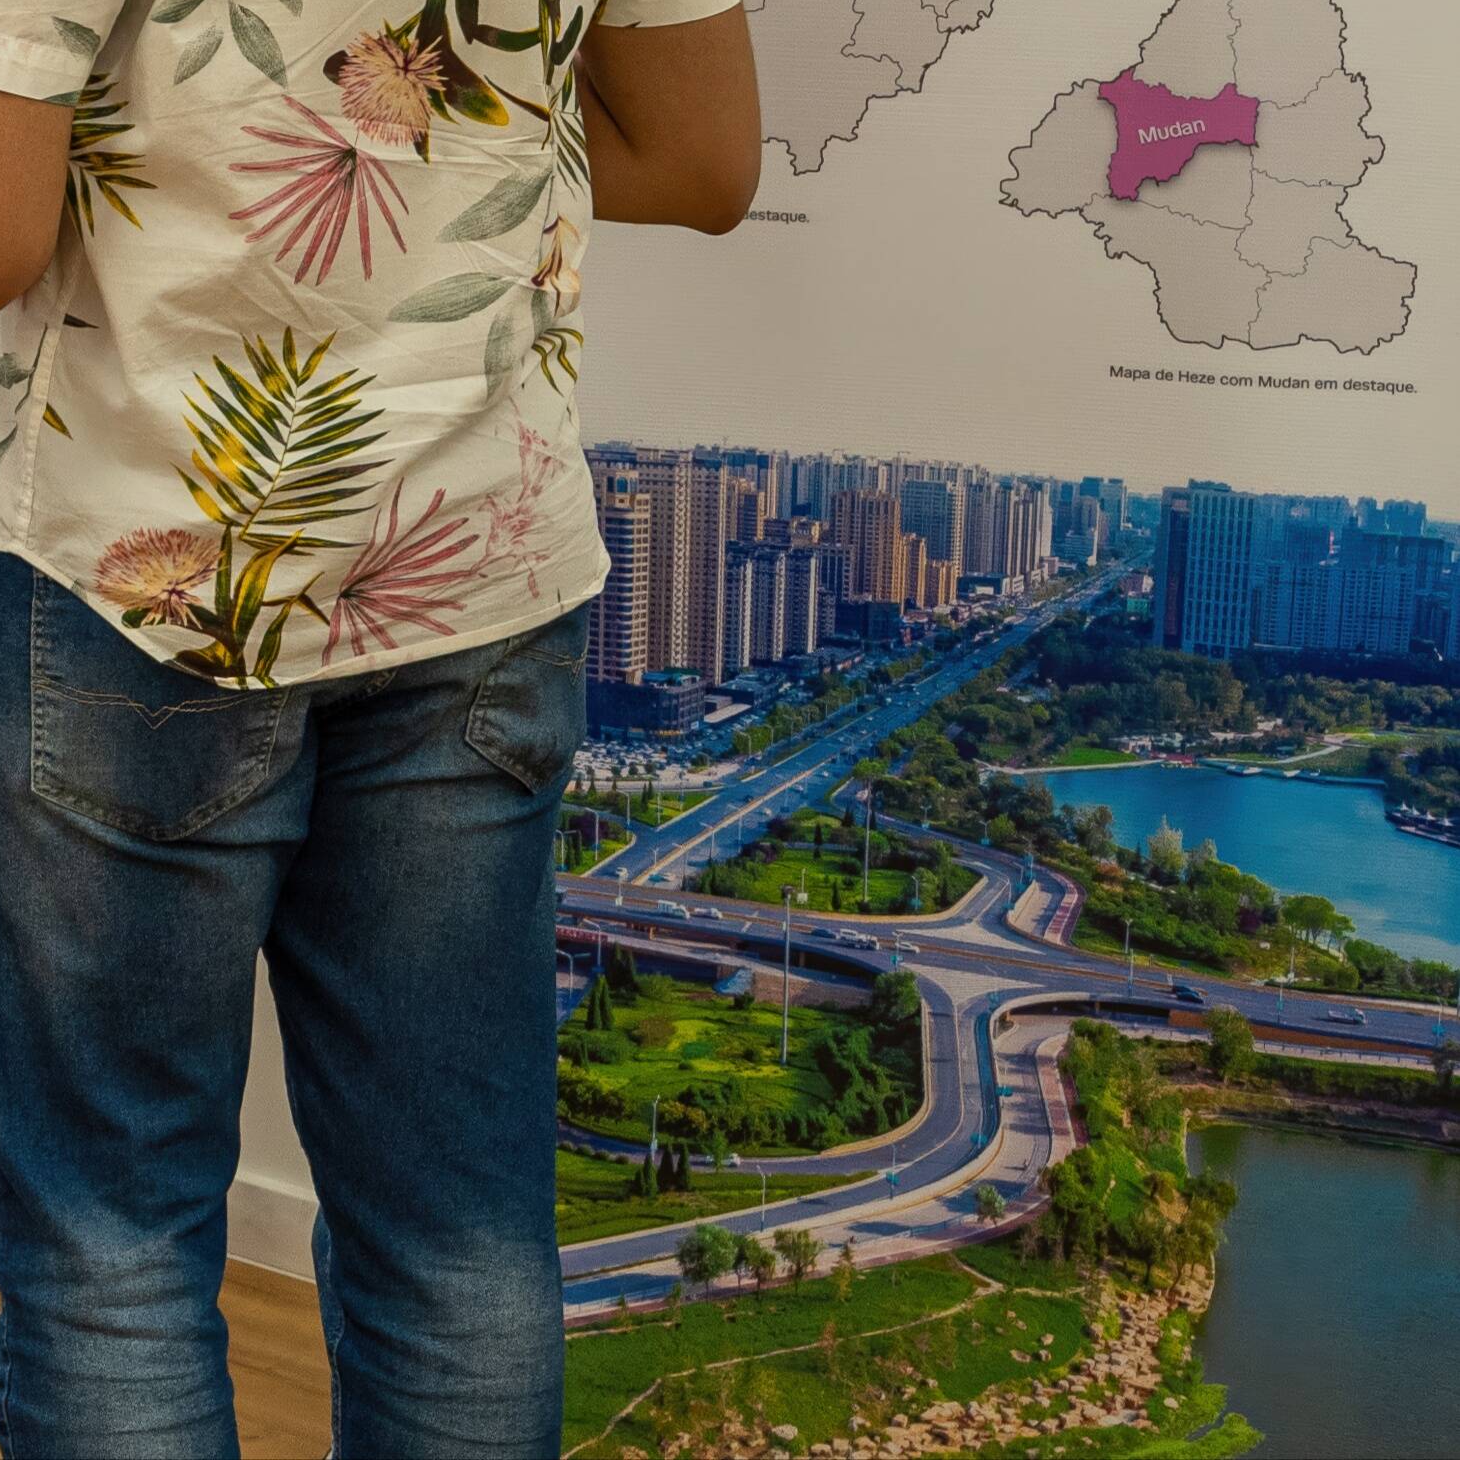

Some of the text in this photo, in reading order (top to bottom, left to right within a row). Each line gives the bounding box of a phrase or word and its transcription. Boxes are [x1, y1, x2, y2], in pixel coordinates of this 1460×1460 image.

[1137, 116, 1207, 145] Mudan
[1108, 364, 1417, 395] Mapa de Heze com Mudan em destaque.
